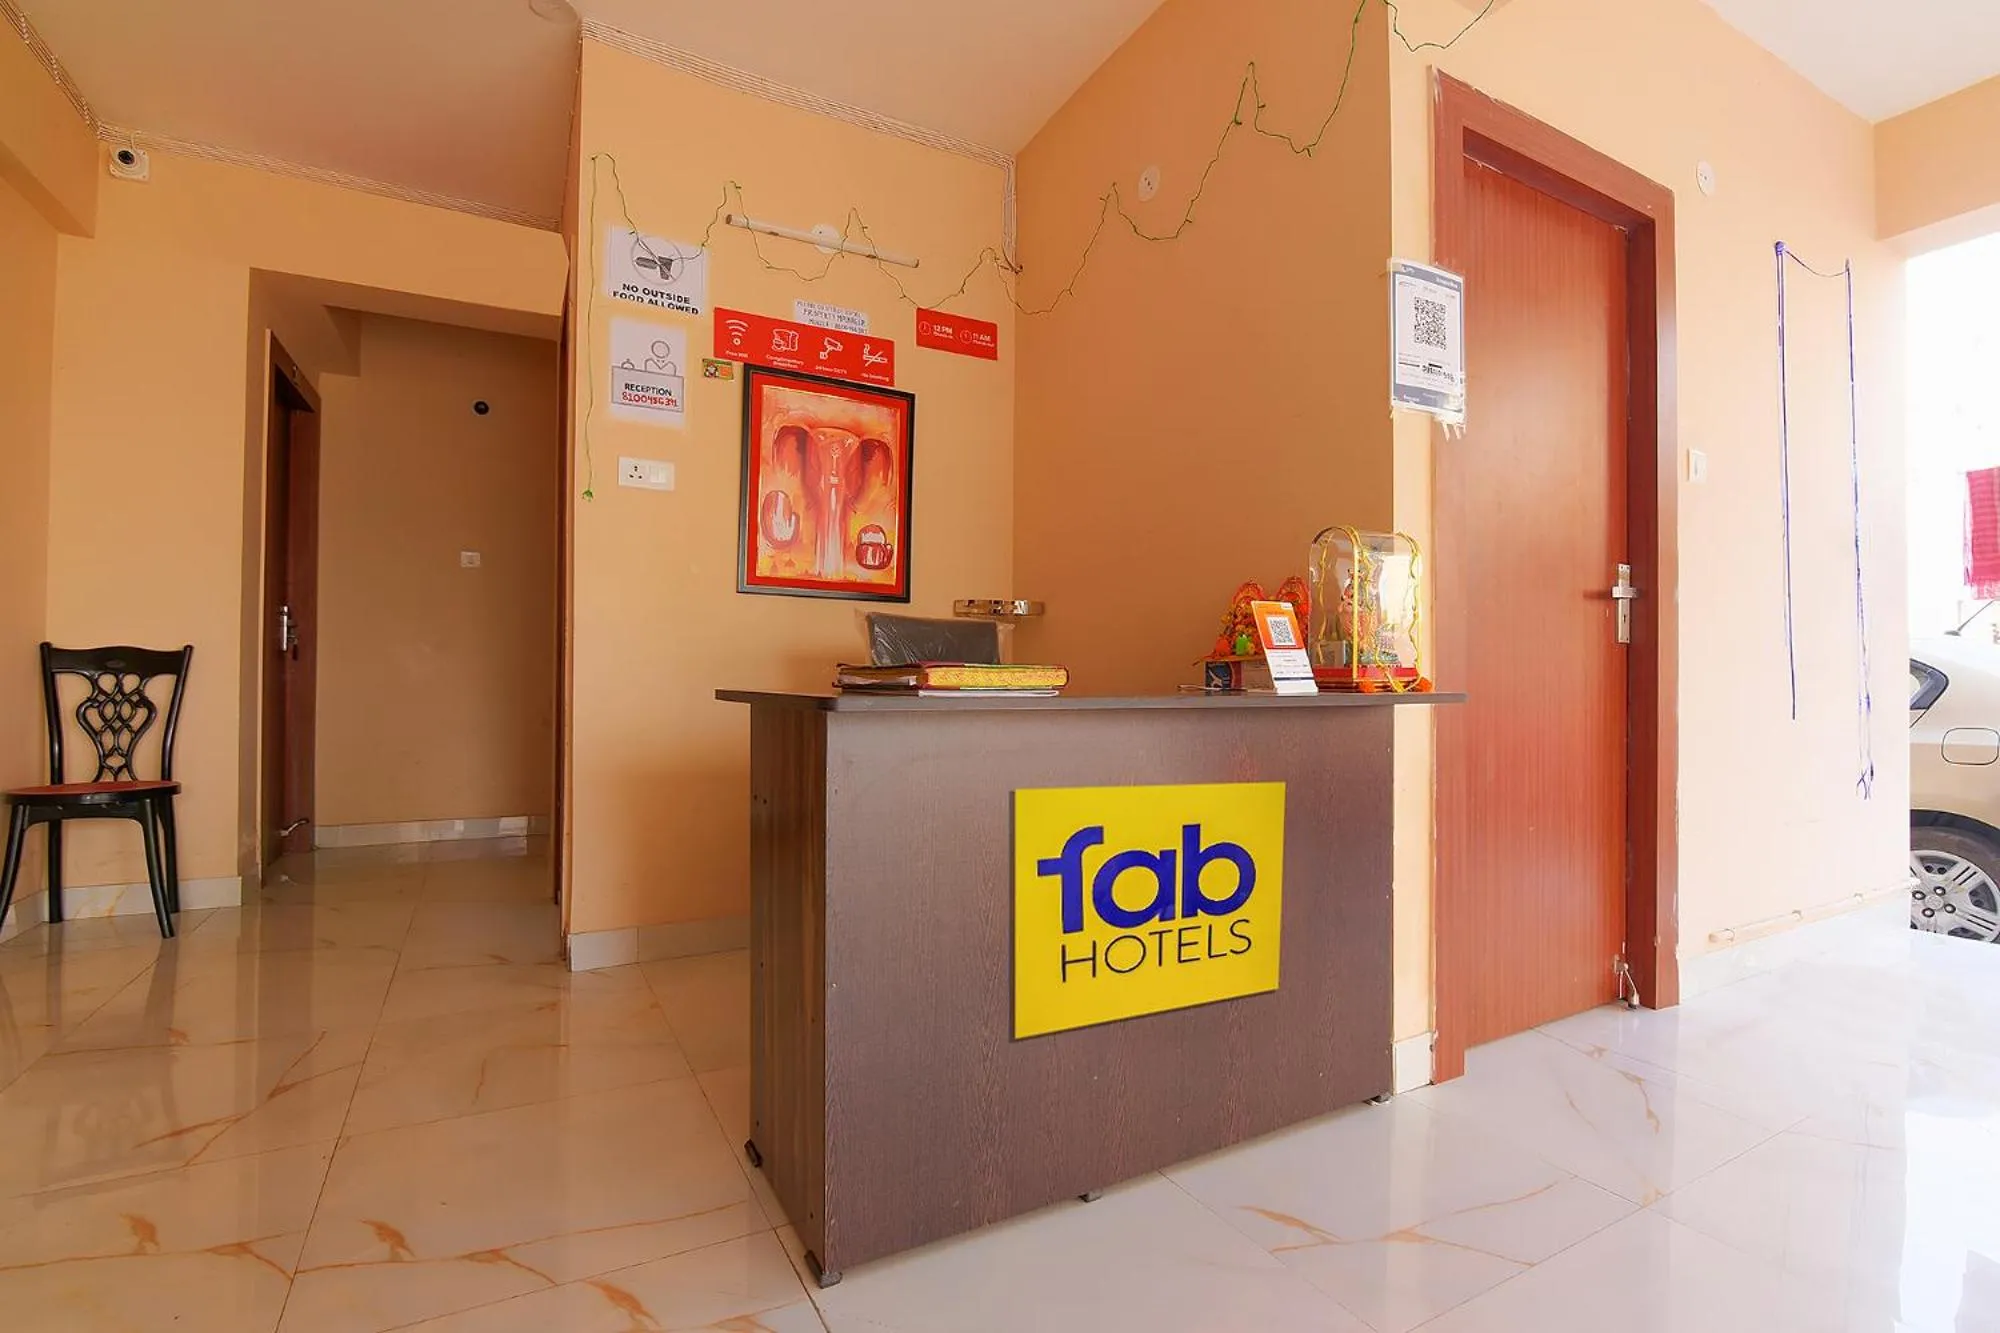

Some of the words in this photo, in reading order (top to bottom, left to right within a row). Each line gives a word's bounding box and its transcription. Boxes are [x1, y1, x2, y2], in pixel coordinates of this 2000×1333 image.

[612, 290, 644, 303] FOOD
[647, 298, 699, 315] ALLOWED
[622, 283, 639, 293] NO
[642, 287, 690, 304] OUTSIDE
[933, 324, 941, 332] 12
[942, 326, 953, 335] PM
[624, 382, 672, 397] RECEPTION
[1036, 823, 1257, 934] fab
[1060, 918, 1252, 983] HOTELS
